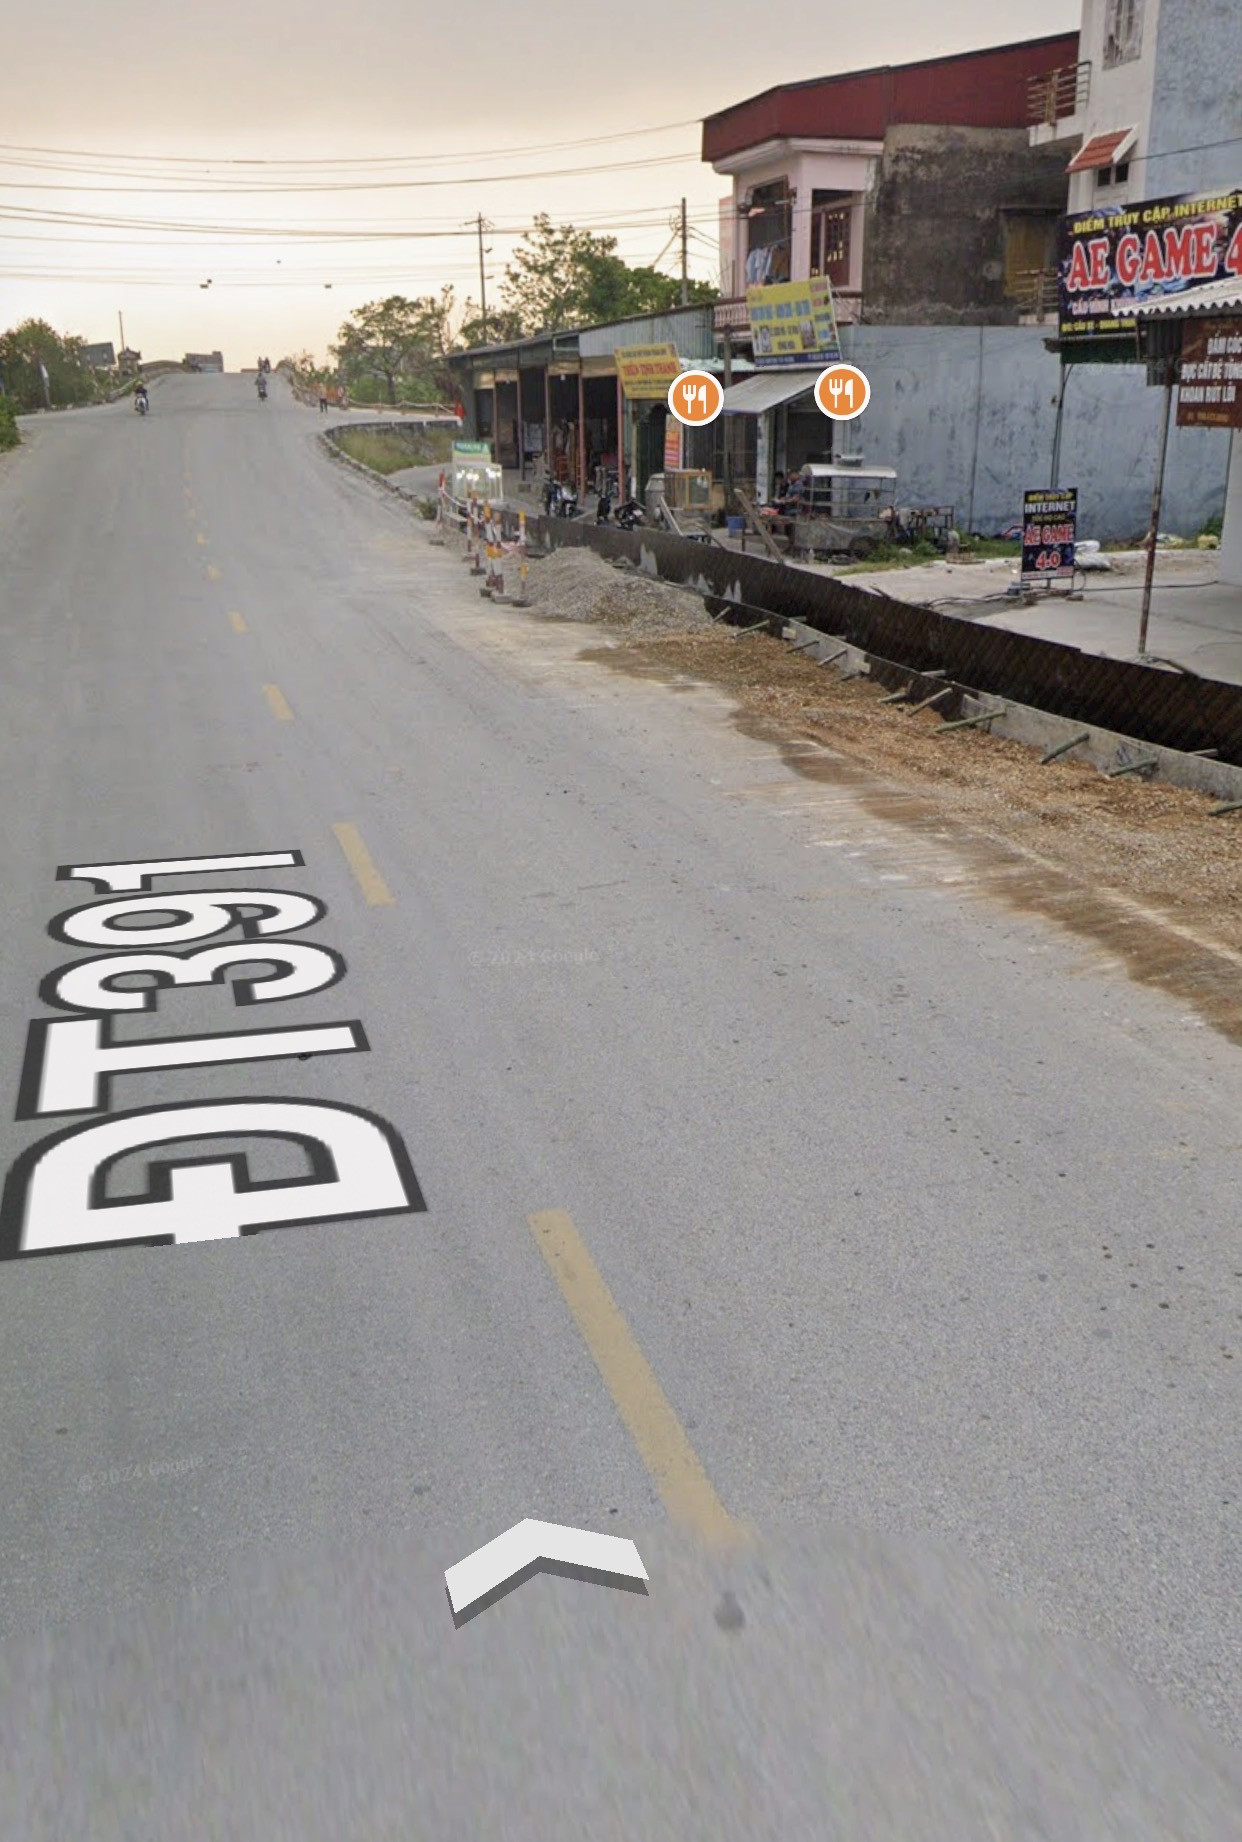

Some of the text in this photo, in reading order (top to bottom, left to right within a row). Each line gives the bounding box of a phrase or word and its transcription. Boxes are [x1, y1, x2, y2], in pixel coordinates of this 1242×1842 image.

[1066, 236, 1110, 292] AE
[1116, 220, 1218, 286] GAME
[1025, 501, 1075, 514] INTERNET
[1042, 524, 1074, 545] GAME
